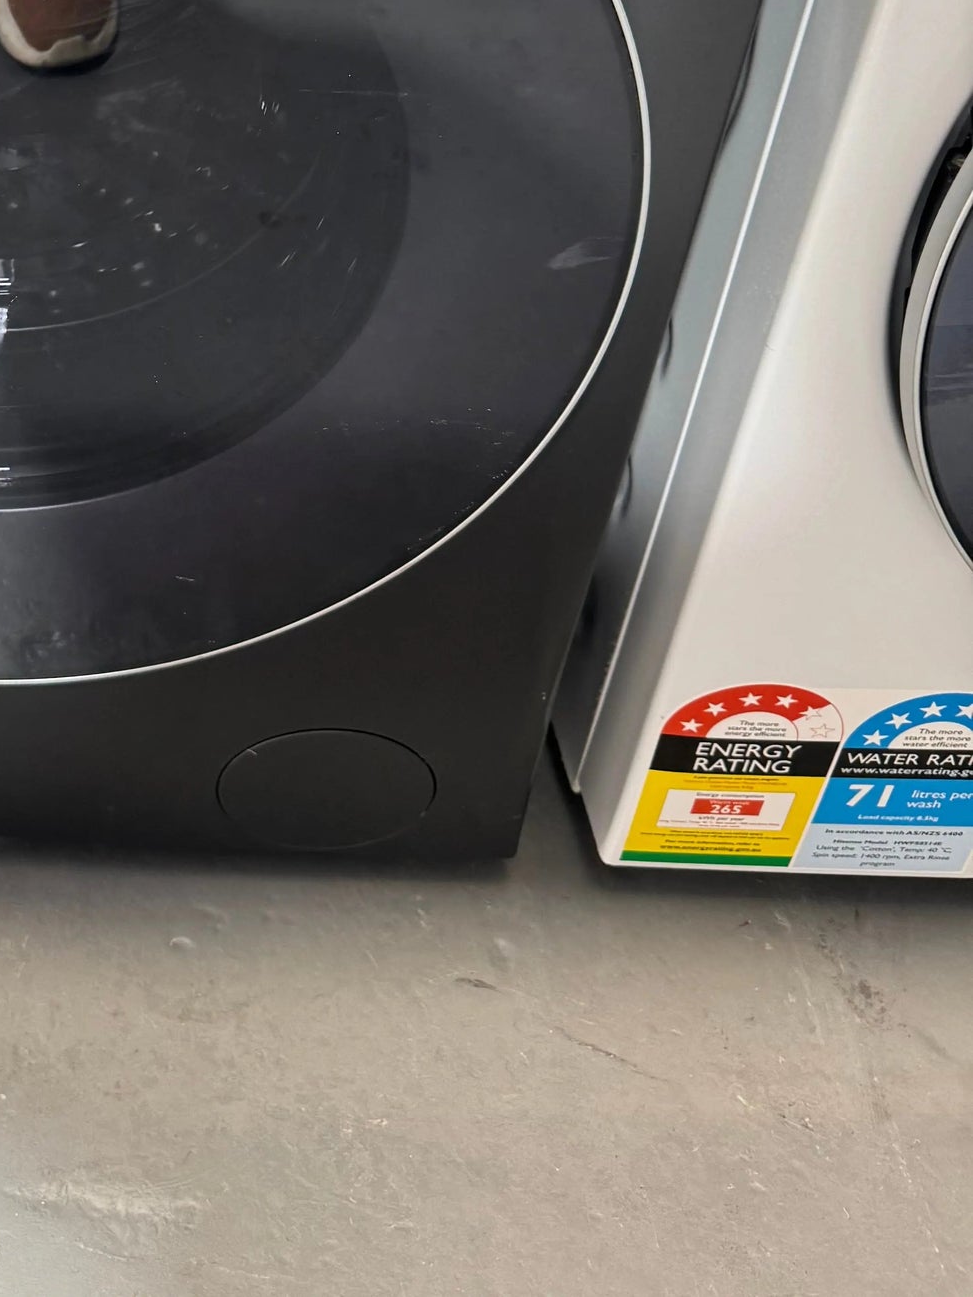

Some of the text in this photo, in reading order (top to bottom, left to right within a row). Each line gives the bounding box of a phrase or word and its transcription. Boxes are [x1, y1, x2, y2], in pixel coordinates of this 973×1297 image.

[696, 742, 802, 758] ENERGY
[847, 753, 919, 765] WATER
[693, 758, 792, 773] RATING
[846, 784, 895, 807] 71
[912, 790, 946, 798] litres
[710, 805, 743, 814] 265
[907, 800, 941, 808] wash
